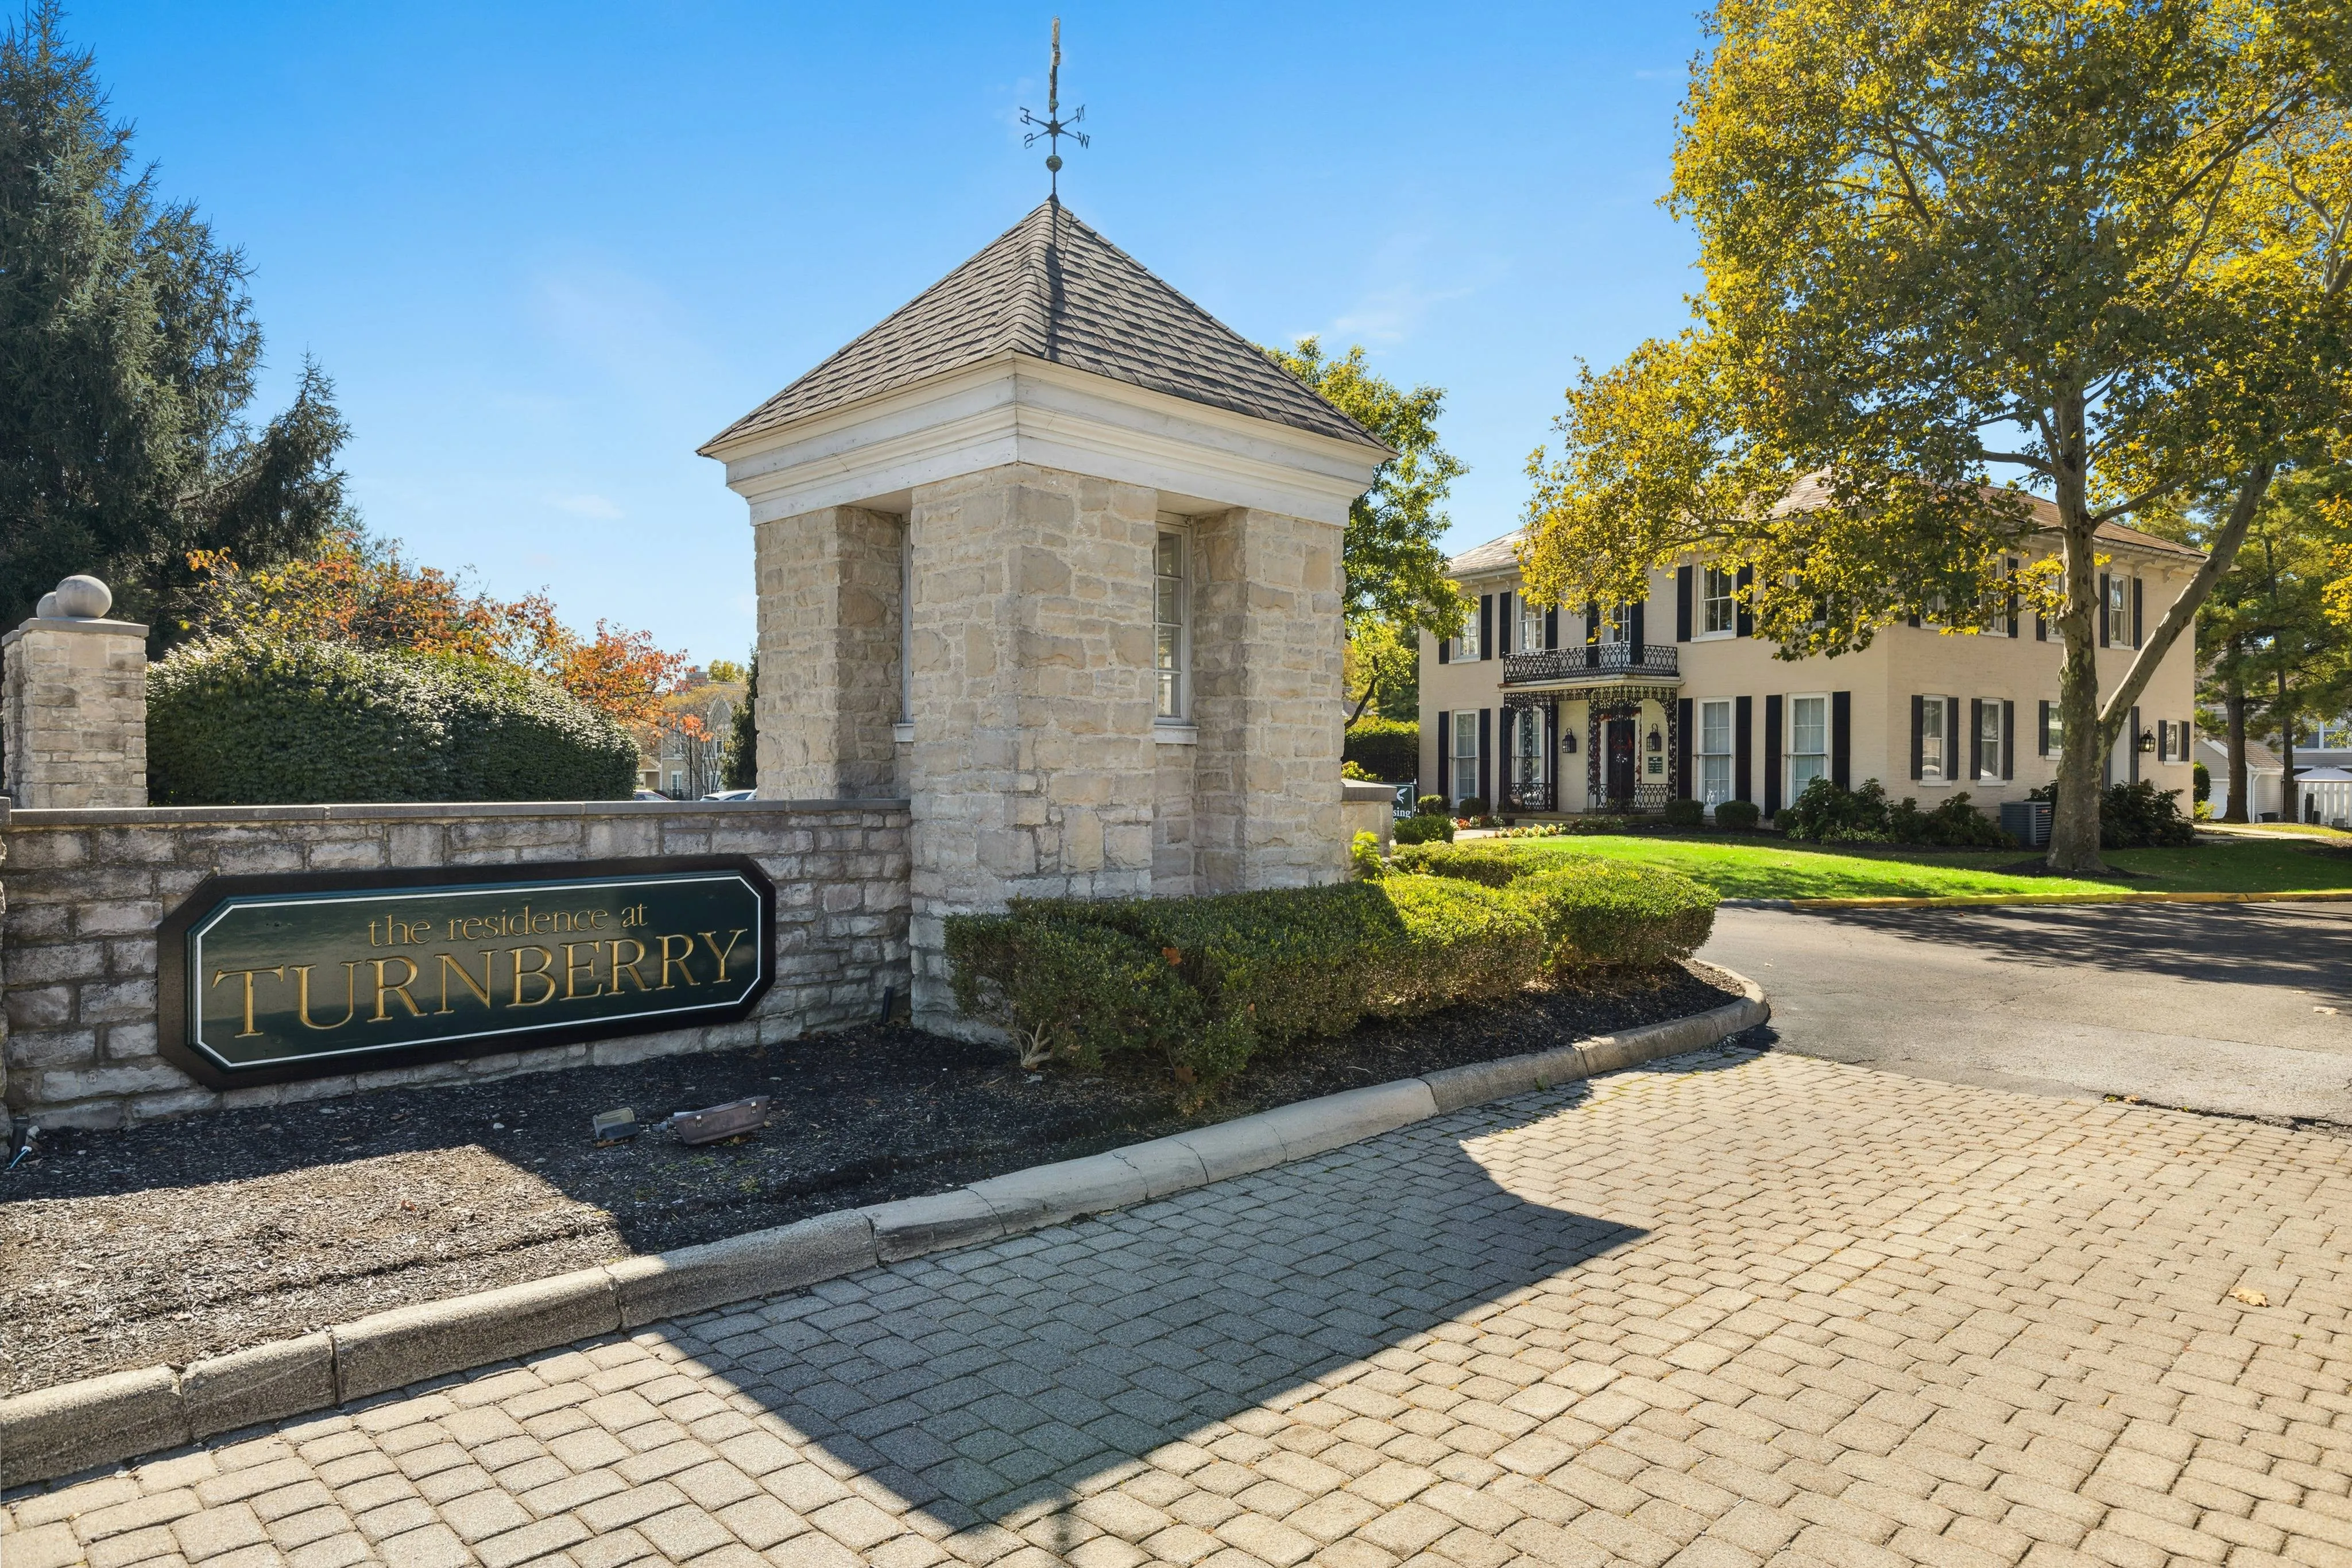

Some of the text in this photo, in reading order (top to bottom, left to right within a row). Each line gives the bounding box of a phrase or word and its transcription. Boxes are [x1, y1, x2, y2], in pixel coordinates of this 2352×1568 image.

[1077, 131, 1090, 149] W
[368, 903, 647, 947] the residence at
[212, 928, 748, 1039] TURNBERRY
